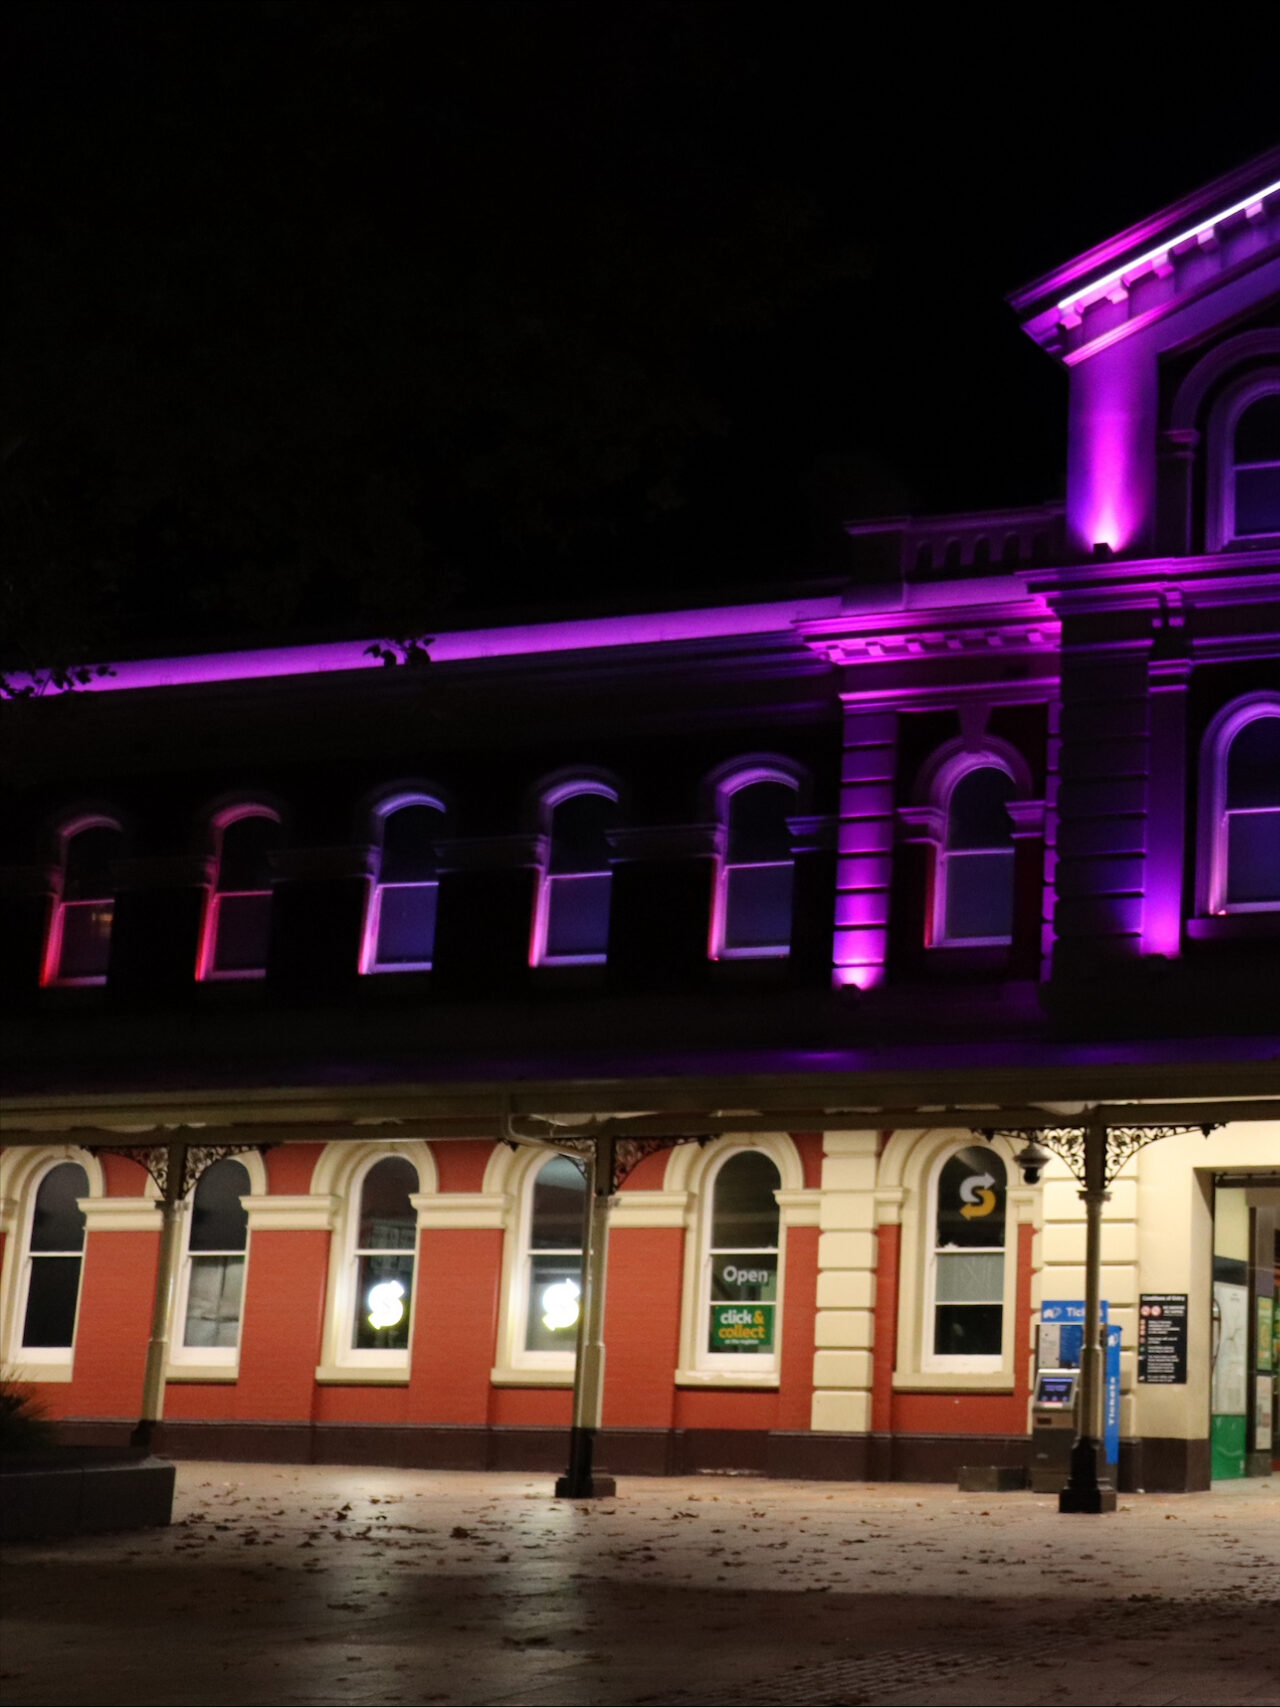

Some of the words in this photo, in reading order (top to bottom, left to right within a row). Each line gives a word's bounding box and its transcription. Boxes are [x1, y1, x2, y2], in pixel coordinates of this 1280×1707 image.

[723, 1265, 769, 1286] Open
[720, 1309, 752, 1324] click
[753, 1309, 765, 1324] &
[718, 1324, 766, 1338] collect
